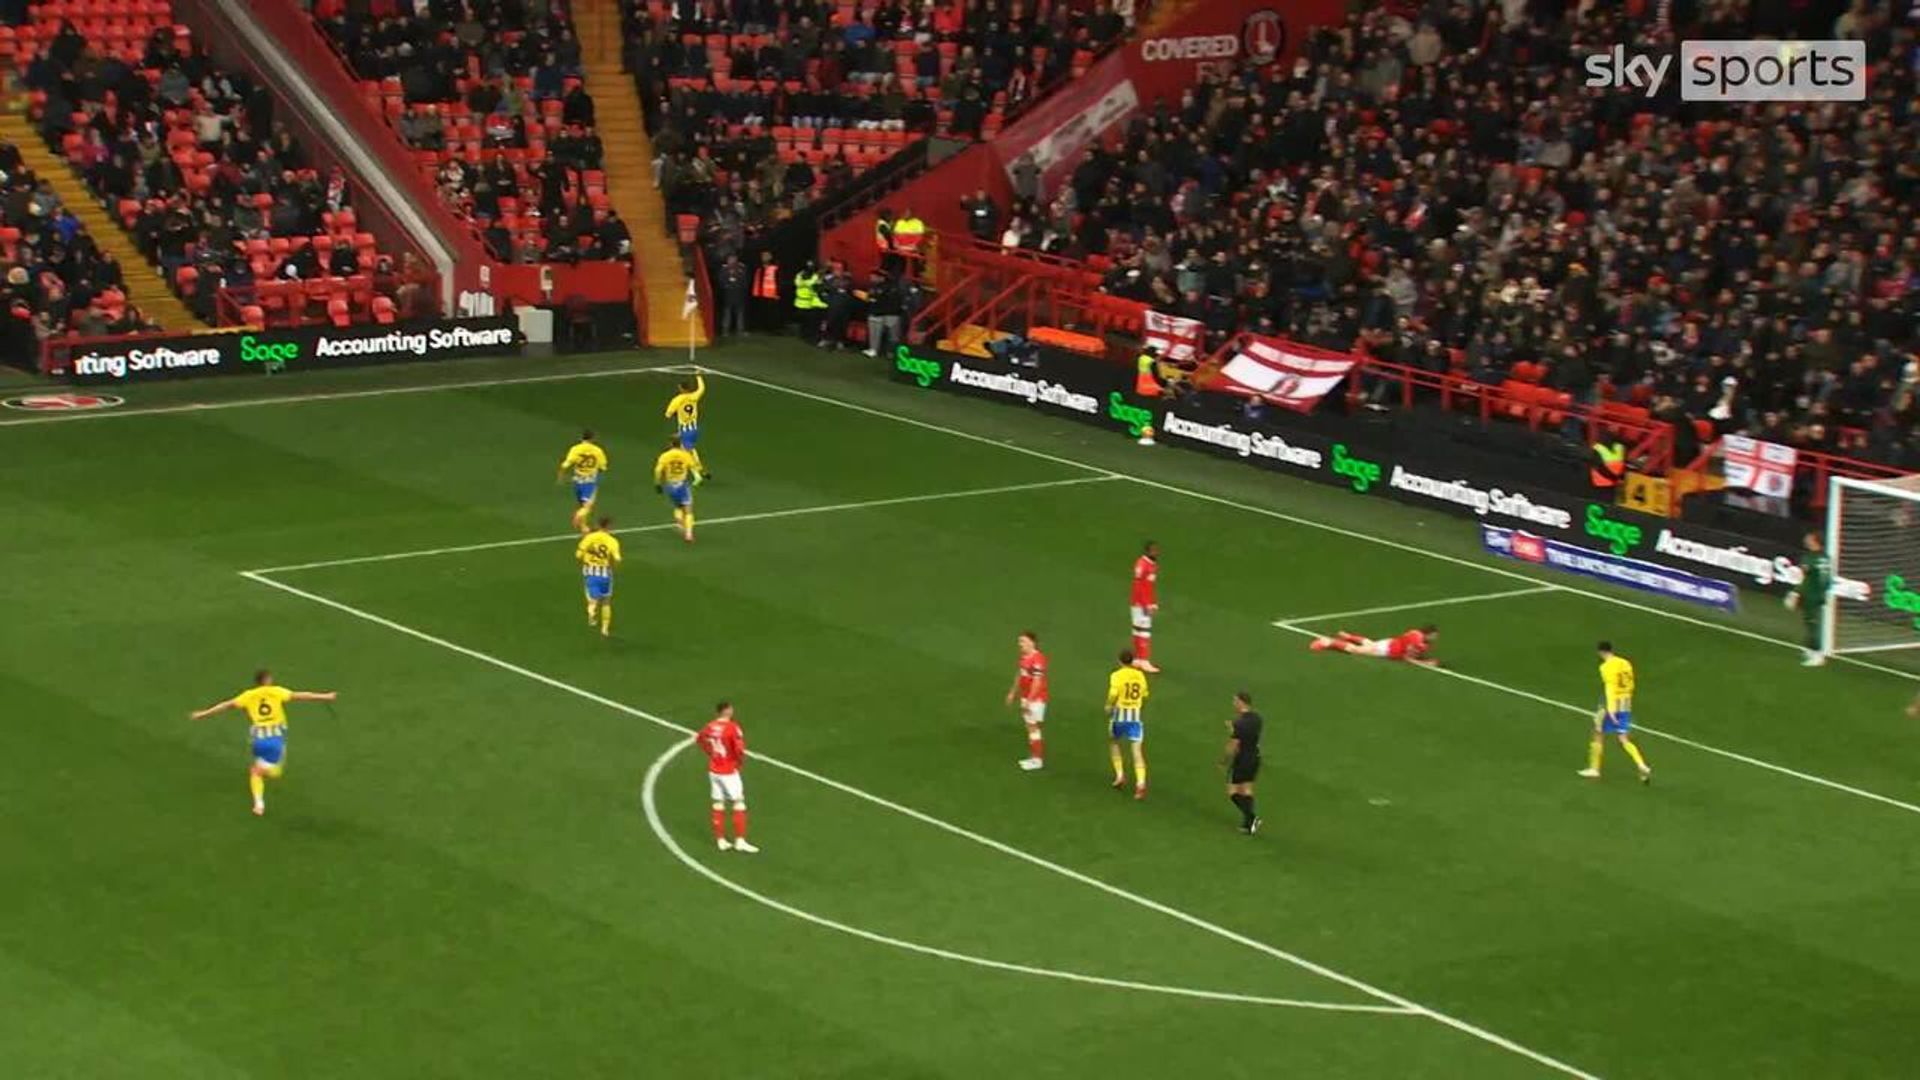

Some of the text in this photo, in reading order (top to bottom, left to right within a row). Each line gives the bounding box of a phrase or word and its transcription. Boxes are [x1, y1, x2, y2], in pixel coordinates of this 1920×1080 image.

[1142, 35, 1238, 61] COVERED
[128, 347, 220, 371] Software
[240, 335, 299, 362] Sage
[316, 326, 512, 357] Accounting Software
[897, 345, 941, 387] Sage
[950, 362, 1099, 414] Accounting Software
[684, 404, 694, 416] 9
[1109, 391, 1153, 437] Sage
[1163, 411, 1322, 469] Accounting Software
[1332, 444, 1381, 492] Sage
[1390, 465, 1571, 529] Accounting Software
[1585, 504, 1642, 556] Sage
[1655, 529, 1773, 584] Accounting
[1772, 556, 1873, 601] Soare
[258, 698, 272, 716] 6
[1124, 682, 1140, 700] 18
